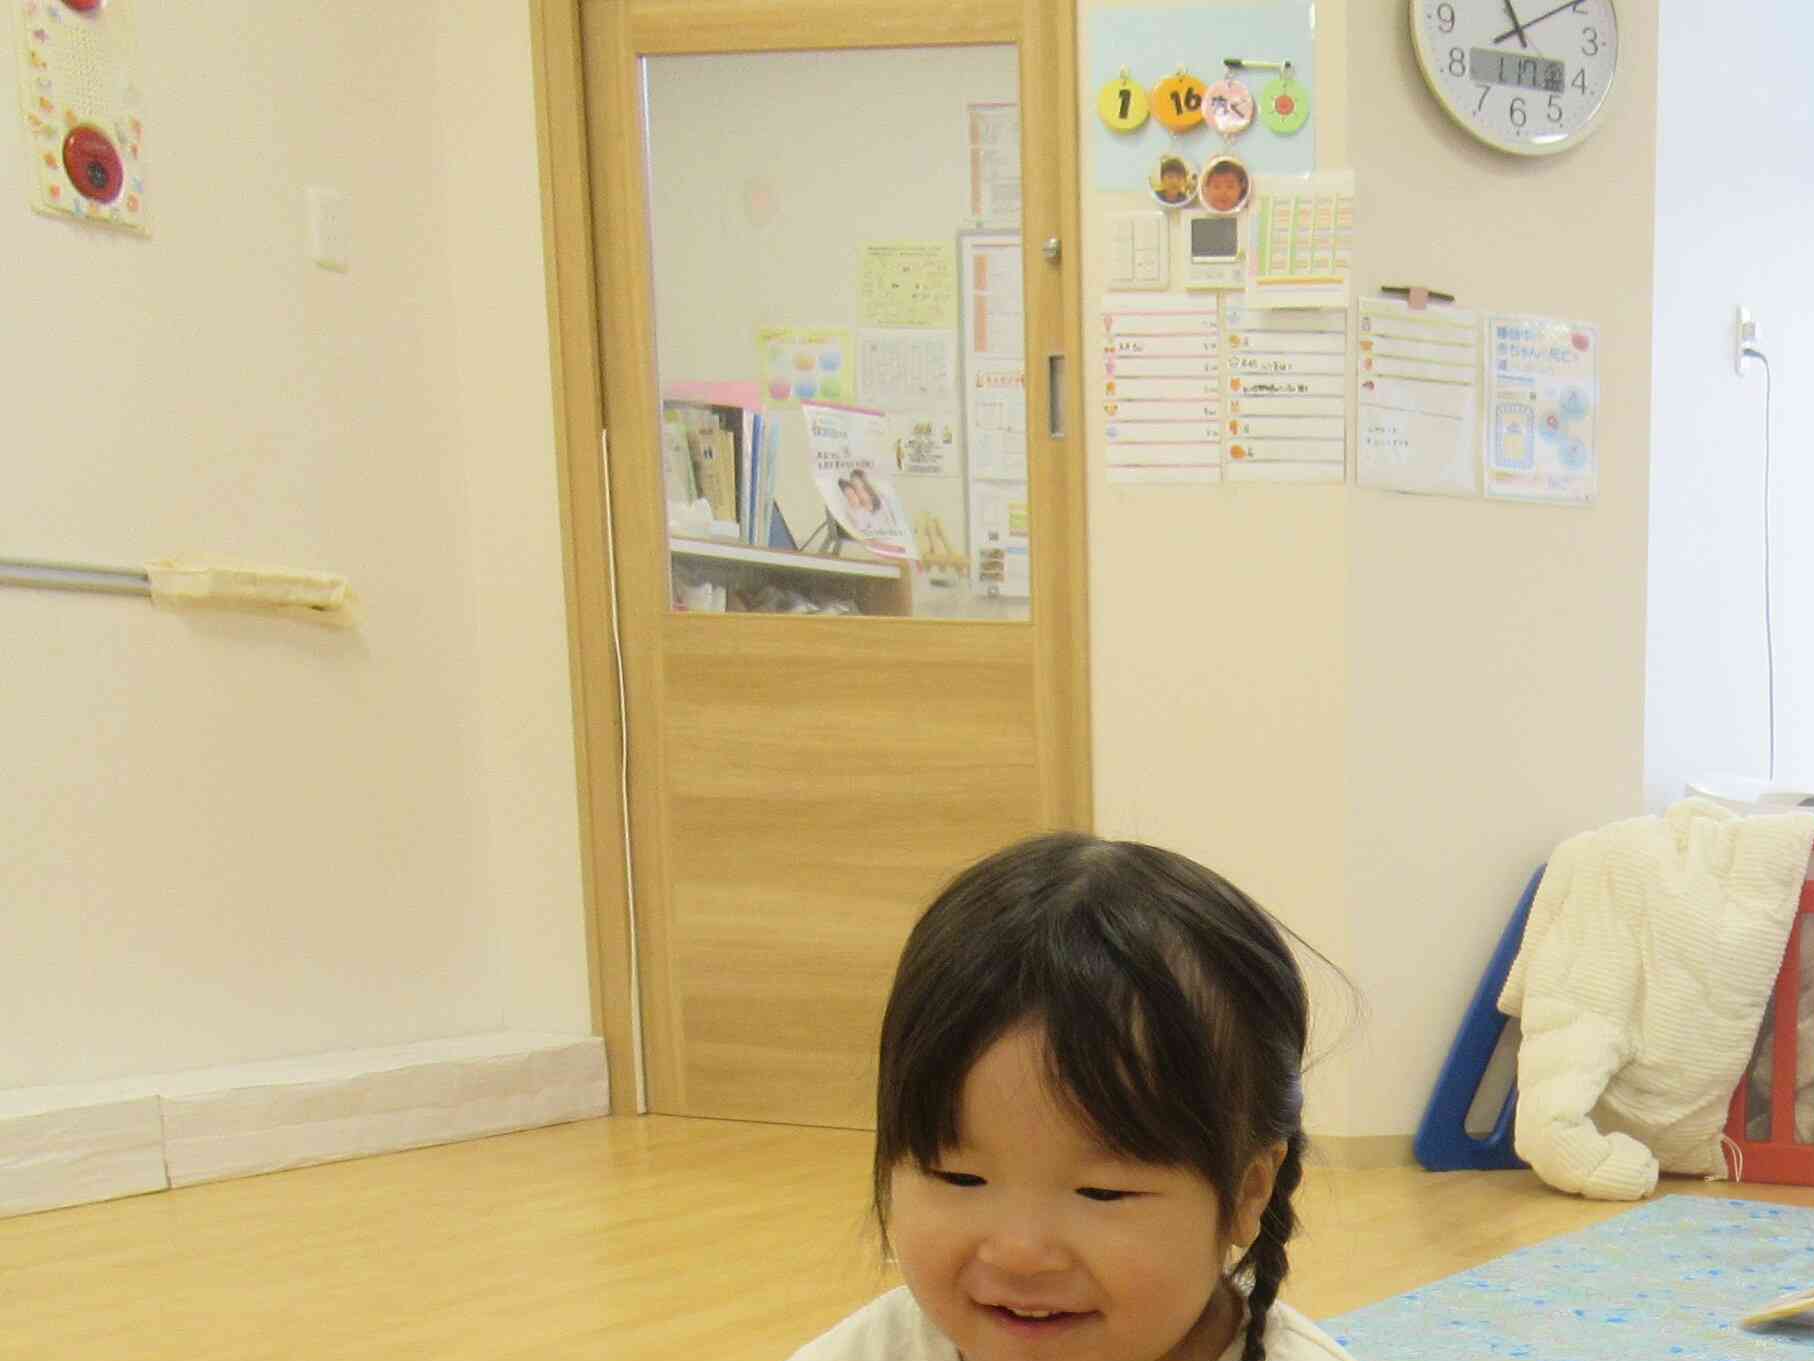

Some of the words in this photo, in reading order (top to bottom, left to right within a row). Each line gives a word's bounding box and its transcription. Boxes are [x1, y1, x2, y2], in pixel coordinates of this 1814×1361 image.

[1436, 3, 1454, 33] 9
[1582, 27, 1598, 56] 3
[1448, 47, 1465, 78] 8
[1571, 67, 1587, 95] 4
[1118, 89, 1131, 120] 1
[1170, 87, 1202, 116] 16
[1474, 84, 1490, 111] 7
[1510, 97, 1526, 127] 6
[1547, 95, 1563, 123] 5
